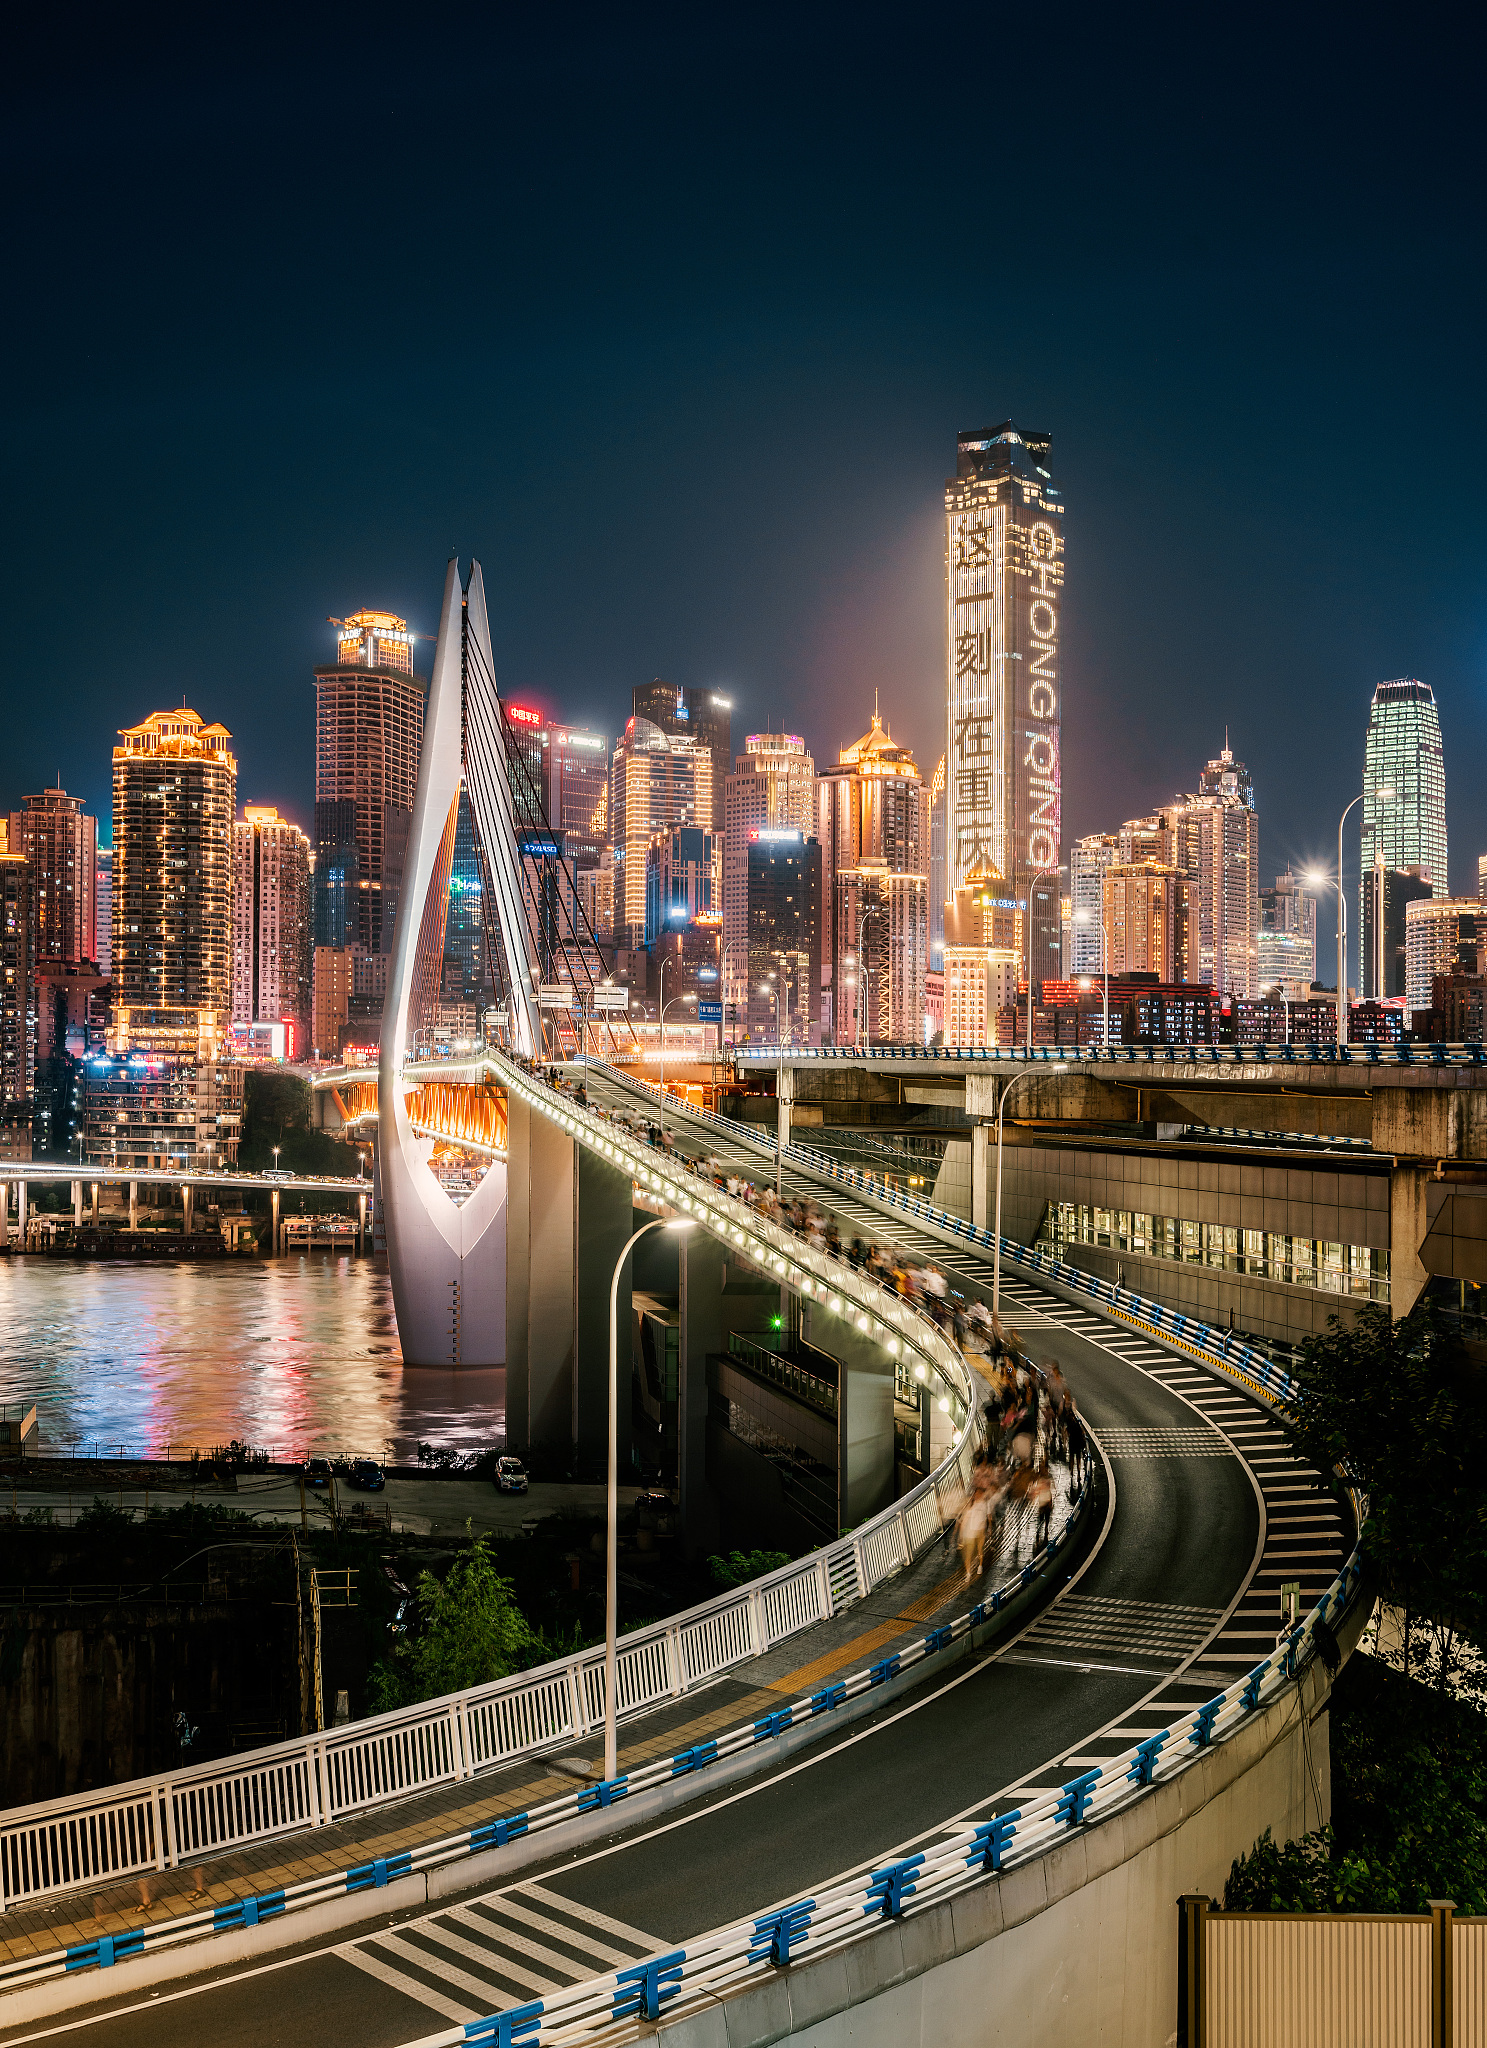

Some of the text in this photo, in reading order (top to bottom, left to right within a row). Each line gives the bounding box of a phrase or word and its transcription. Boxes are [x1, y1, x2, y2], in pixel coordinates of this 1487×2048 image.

[511, 707, 540, 725] 中国平安
[955, 517, 994, 867] 这一刻在重庆
[1023, 521, 1056, 868] CHONG QING
